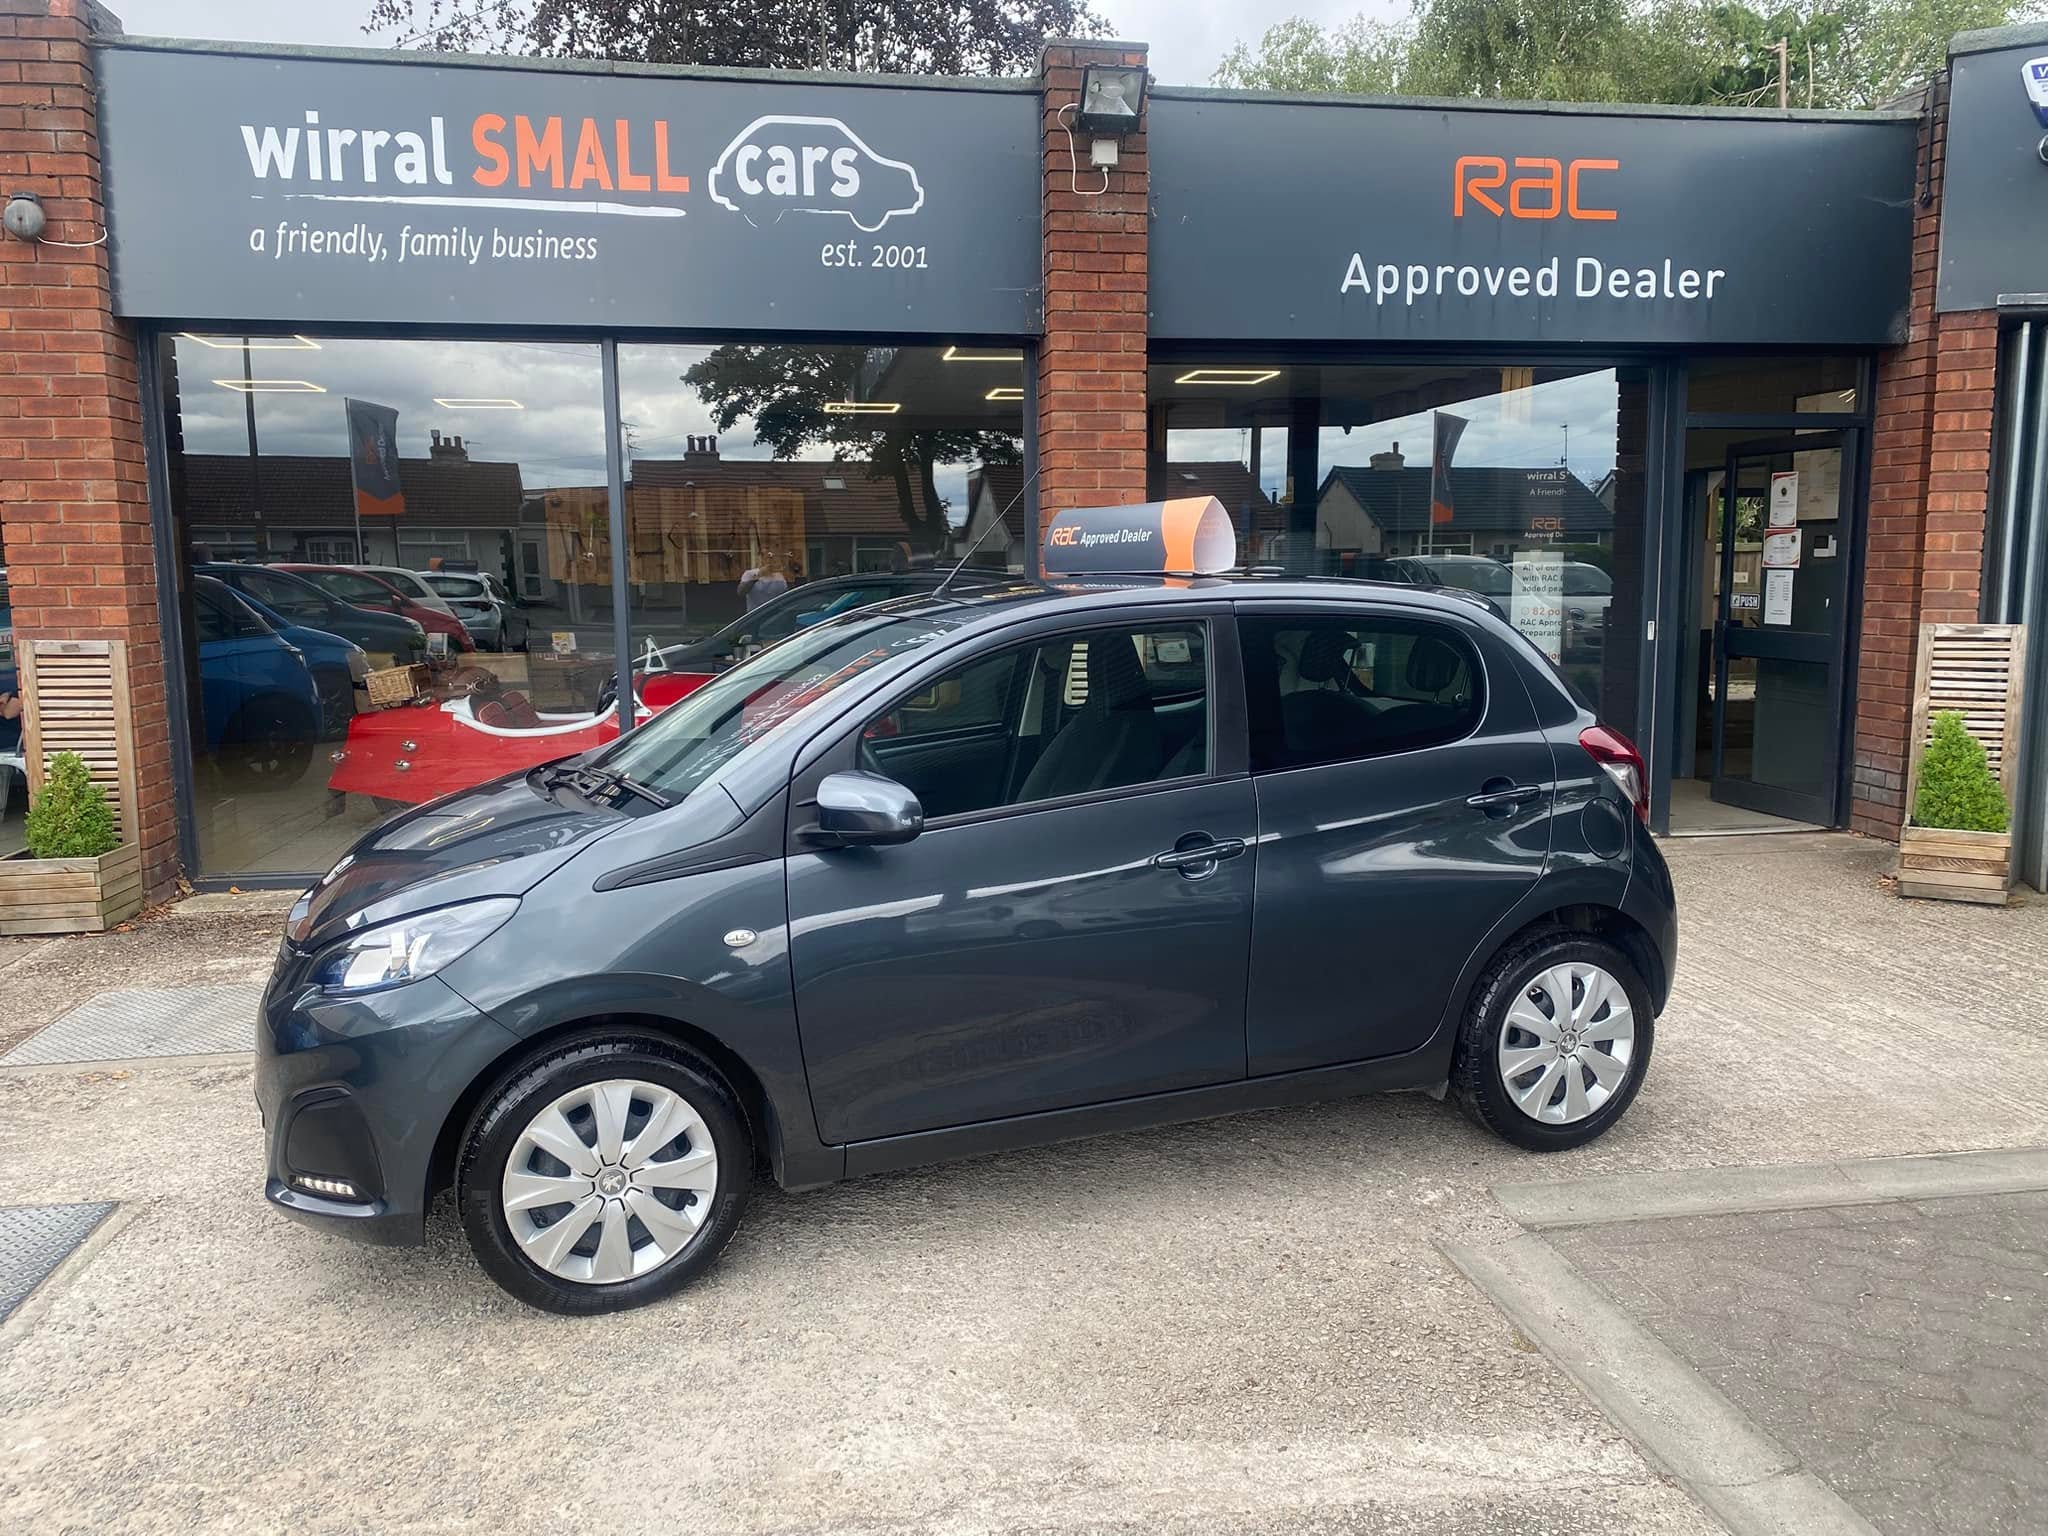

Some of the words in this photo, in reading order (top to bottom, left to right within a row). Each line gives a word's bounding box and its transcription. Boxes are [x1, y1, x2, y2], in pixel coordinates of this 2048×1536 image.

[240, 110, 453, 185] wirral
[471, 113, 690, 192] SMALL
[735, 145, 860, 197] cars
[250, 227, 265, 251] a
[275, 221, 387, 262] friendly,
[398, 225, 484, 264] family
[492, 227, 598, 259] business
[821, 239, 862, 267] est.
[871, 245, 928, 268] 2001
[1340, 253, 1558, 305] Approved
[1575, 257, 1725, 299] Dealer
[1527, 471, 1557, 480] wirral
[1080, 531, 1121, 548] Approved
[1121, 528, 1152, 543] Dealer
